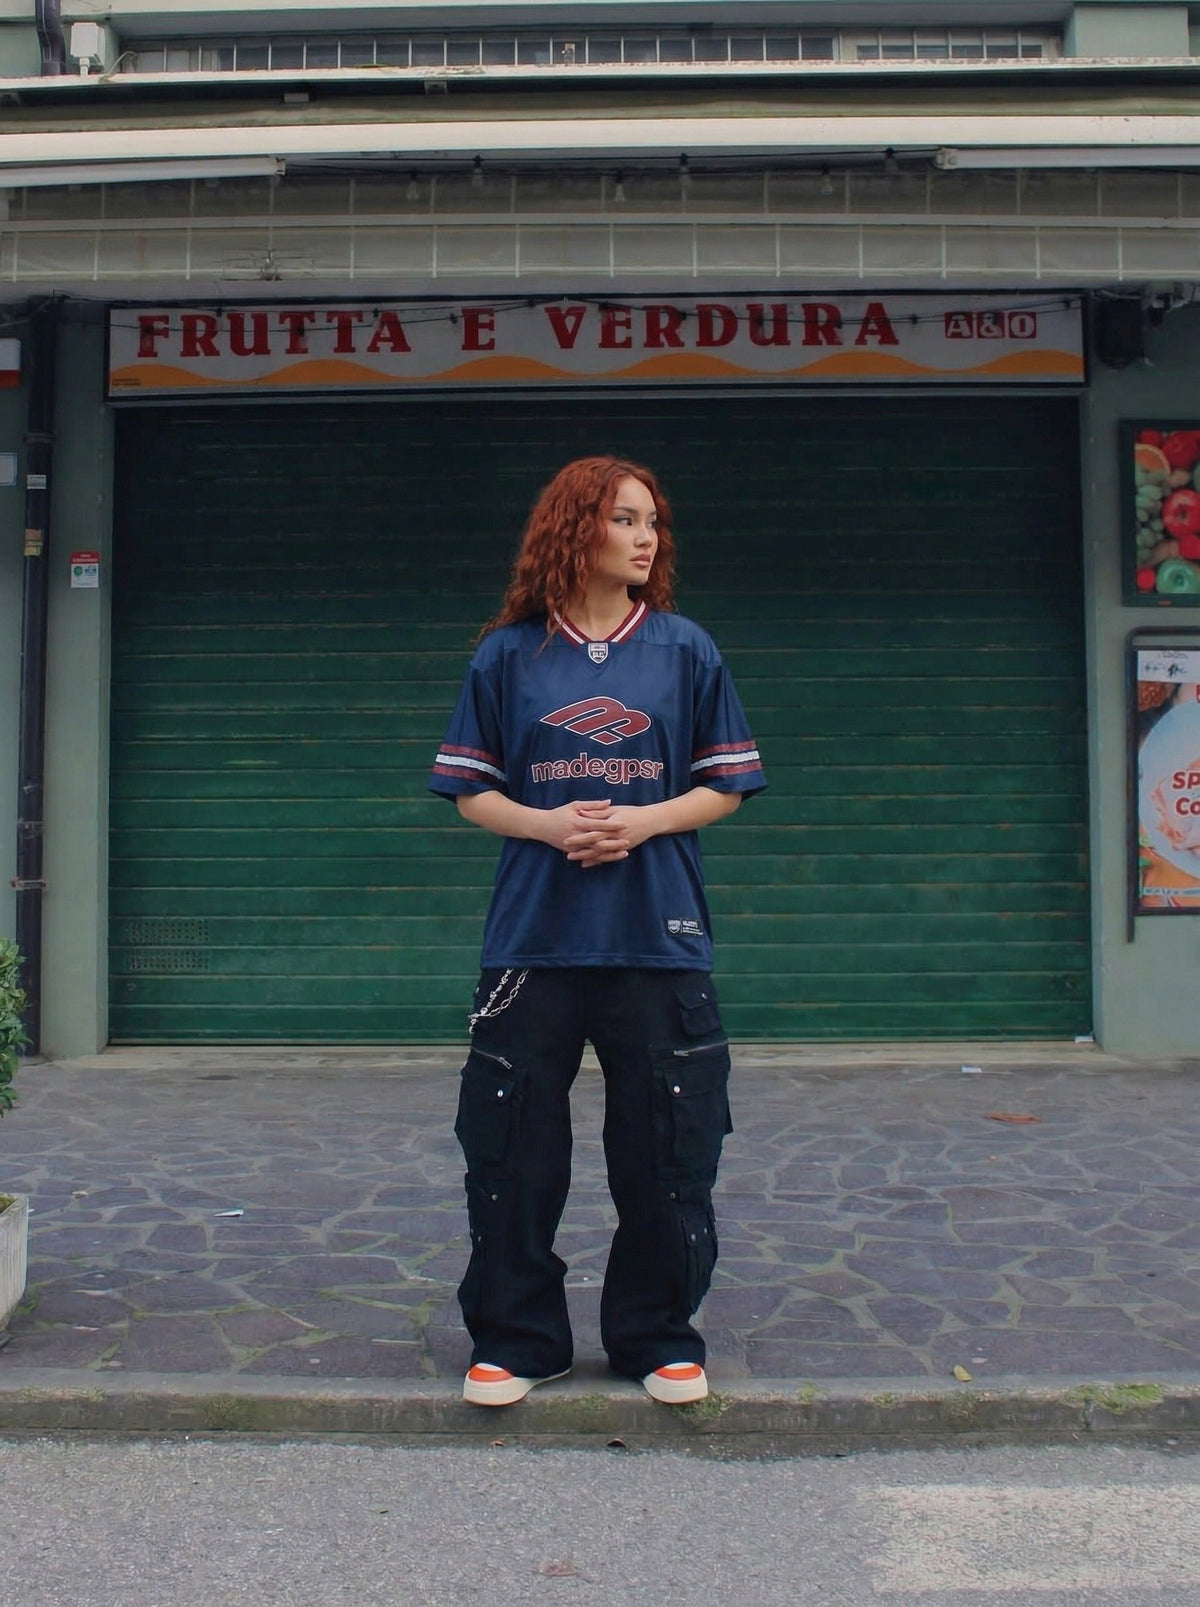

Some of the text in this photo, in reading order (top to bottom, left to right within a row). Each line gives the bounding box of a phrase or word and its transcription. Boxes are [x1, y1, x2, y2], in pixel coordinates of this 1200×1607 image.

[137, 302, 900, 357] FRUTTA E VERDURA
[945, 311, 1037, 339] A&O
[531, 752, 664, 785] madegpsr
